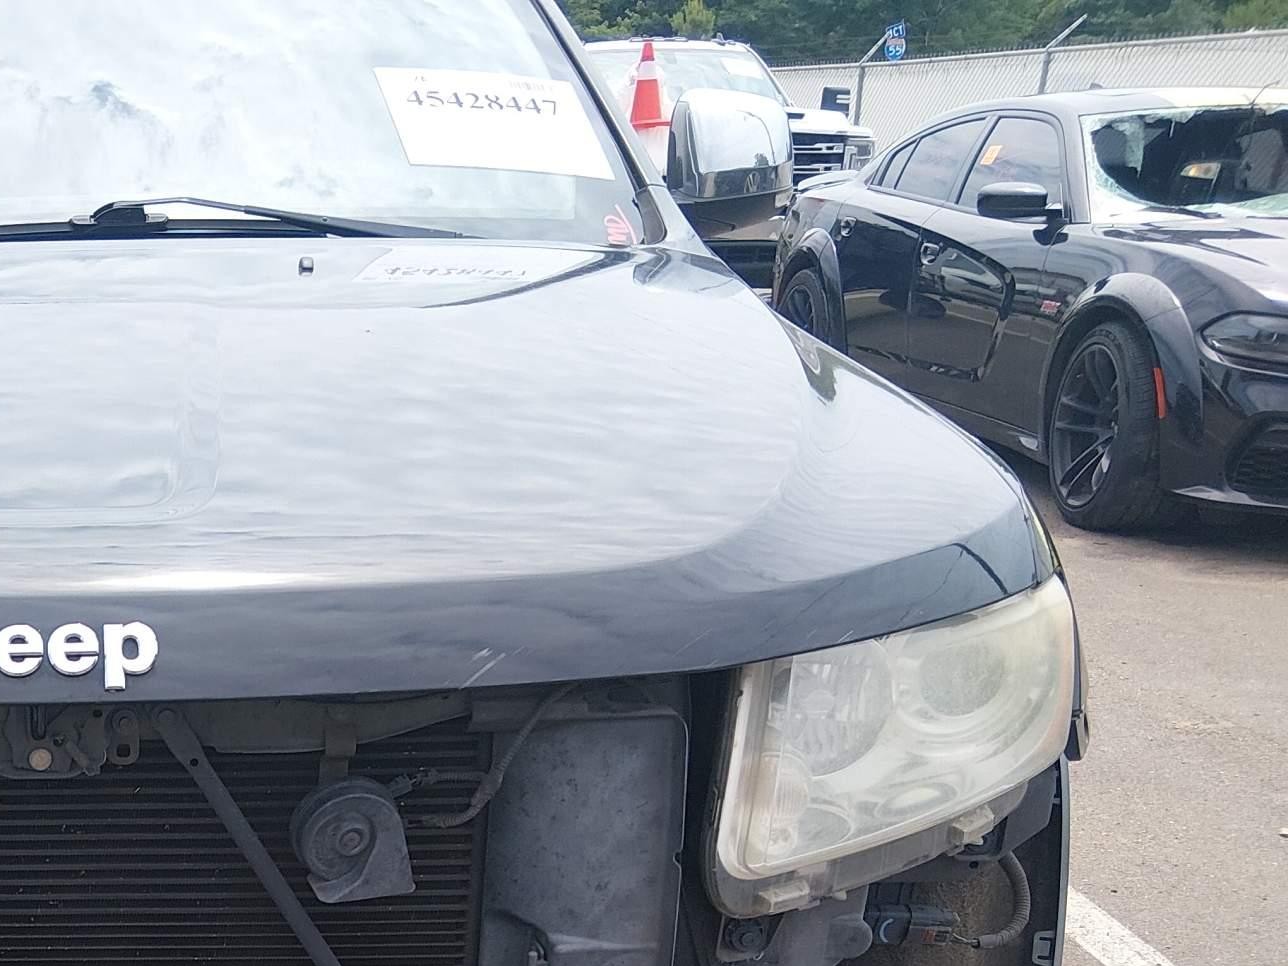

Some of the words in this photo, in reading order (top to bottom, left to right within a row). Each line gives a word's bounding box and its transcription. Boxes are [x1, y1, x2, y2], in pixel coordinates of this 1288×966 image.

[889, 25, 904, 38] JCT
[888, 45, 902, 56] 55
[406, 89, 557, 115] 45428447
